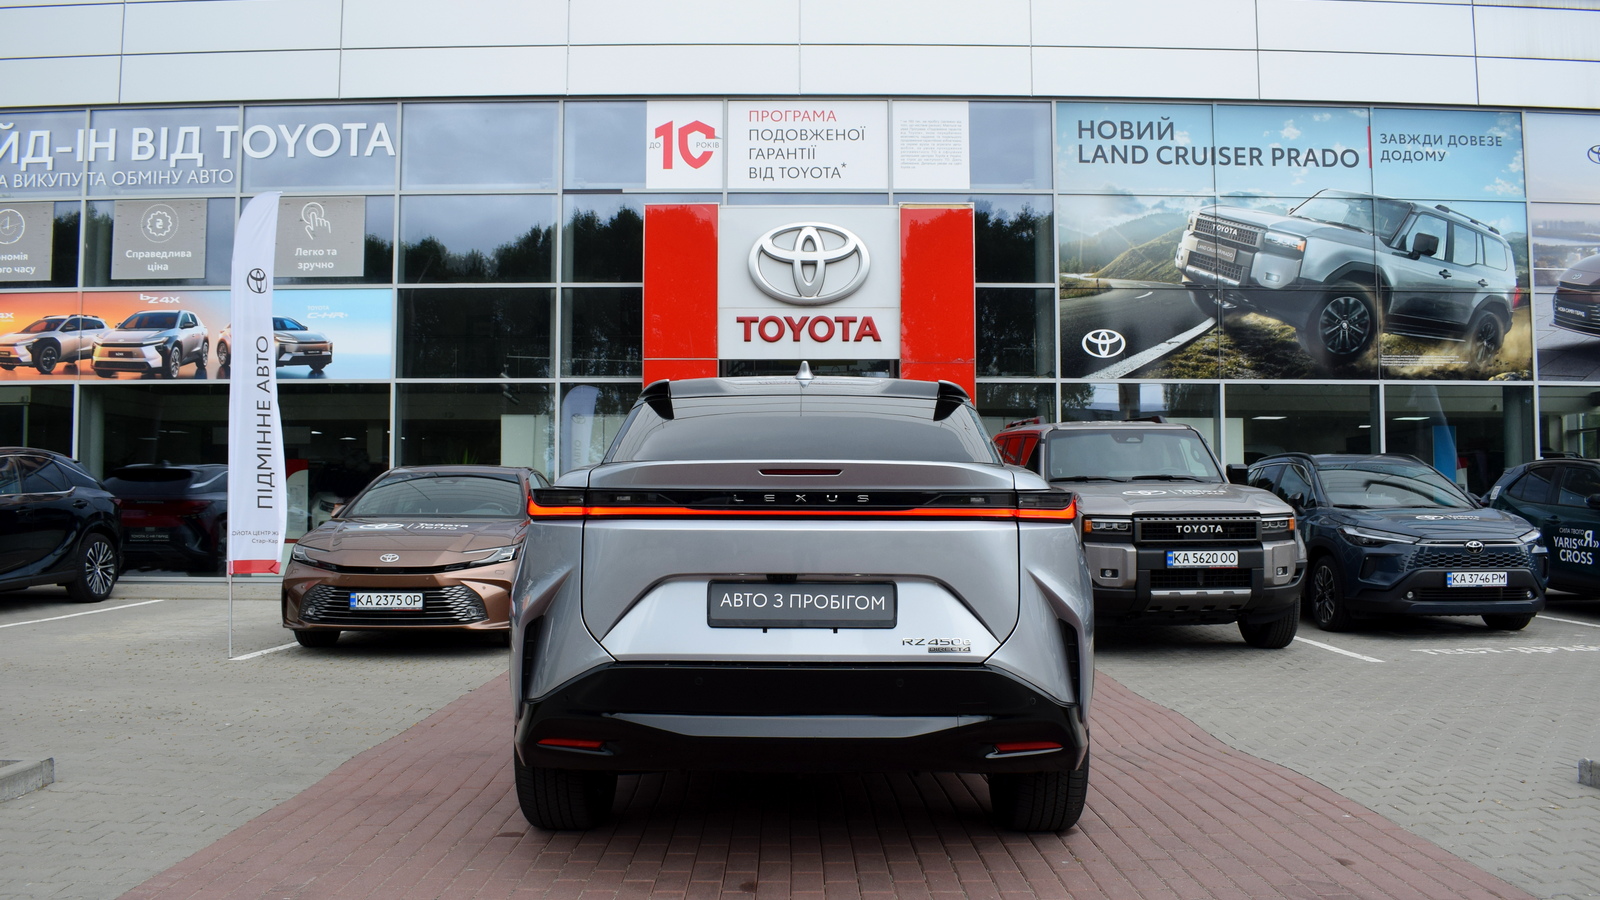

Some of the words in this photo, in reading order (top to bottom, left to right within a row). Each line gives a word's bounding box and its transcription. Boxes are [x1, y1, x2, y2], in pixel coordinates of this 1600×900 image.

[749, 110, 837, 122] ПРОГРАМА
[749, 125, 866, 143] ПОДОВЖЕНОЇ
[1078, 116, 1175, 141] НОВИЙ
[131, 126, 204, 168] ВІД
[216, 122, 396, 159] TOYOTA
[1380, 133, 1443, 147] ЗАВЖДИ
[1448, 135, 1503, 148] ДОВЕЗЕ
[749, 144, 817, 160] ГАРАНТІЇ
[1078, 144, 1149, 164] LAND
[1156, 145, 1264, 166] CRUISER
[1271, 147, 1360, 168] PRADO
[1380, 150, 1446, 163] ДОДОМУ
[13, 172, 83, 188] ВИКУПУ
[87, 171, 107, 186] ТА
[111, 169, 183, 186] ОБМІНУ
[187, 168, 234, 184] АВТО
[749, 166, 775, 182] ВІД
[1212, 224, 1238, 236] TOYOTA
[0, 251, 28, 260] номія
[125, 250, 192, 259] Справедлива
[294, 247, 325, 256] Легко
[326, 248, 337, 256] та
[14, 266, 36, 275] часу
[147, 262, 169, 271] ціна
[297, 262, 334, 271] зручно
[736, 315, 882, 343] TOYOTA
[256, 336, 270, 393] АВТО
[257, 400, 275, 509] ПІДМІННЕ
[733, 494, 869, 502] LEXUS
[1176, 524, 1223, 533] TOYOTA
[1553, 536, 1578, 549] YARIS
[1173, 552, 1190, 564] KA
[1192, 552, 1218, 564] 5620
[1559, 549, 1593, 565] CROSS
[1452, 574, 1467, 584] KA
[1468, 574, 1491, 584] 3746
[1491, 574, 1506, 584] PM
[356, 595, 373, 606] KA
[375, 595, 403, 606] 2375
[405, 595, 422, 606] OP
[720, 592, 768, 608] АВТО
[773, 593, 783, 608] З
[789, 594, 885, 611] ПРОБІГОМ
[902, 638, 926, 646] RZ
